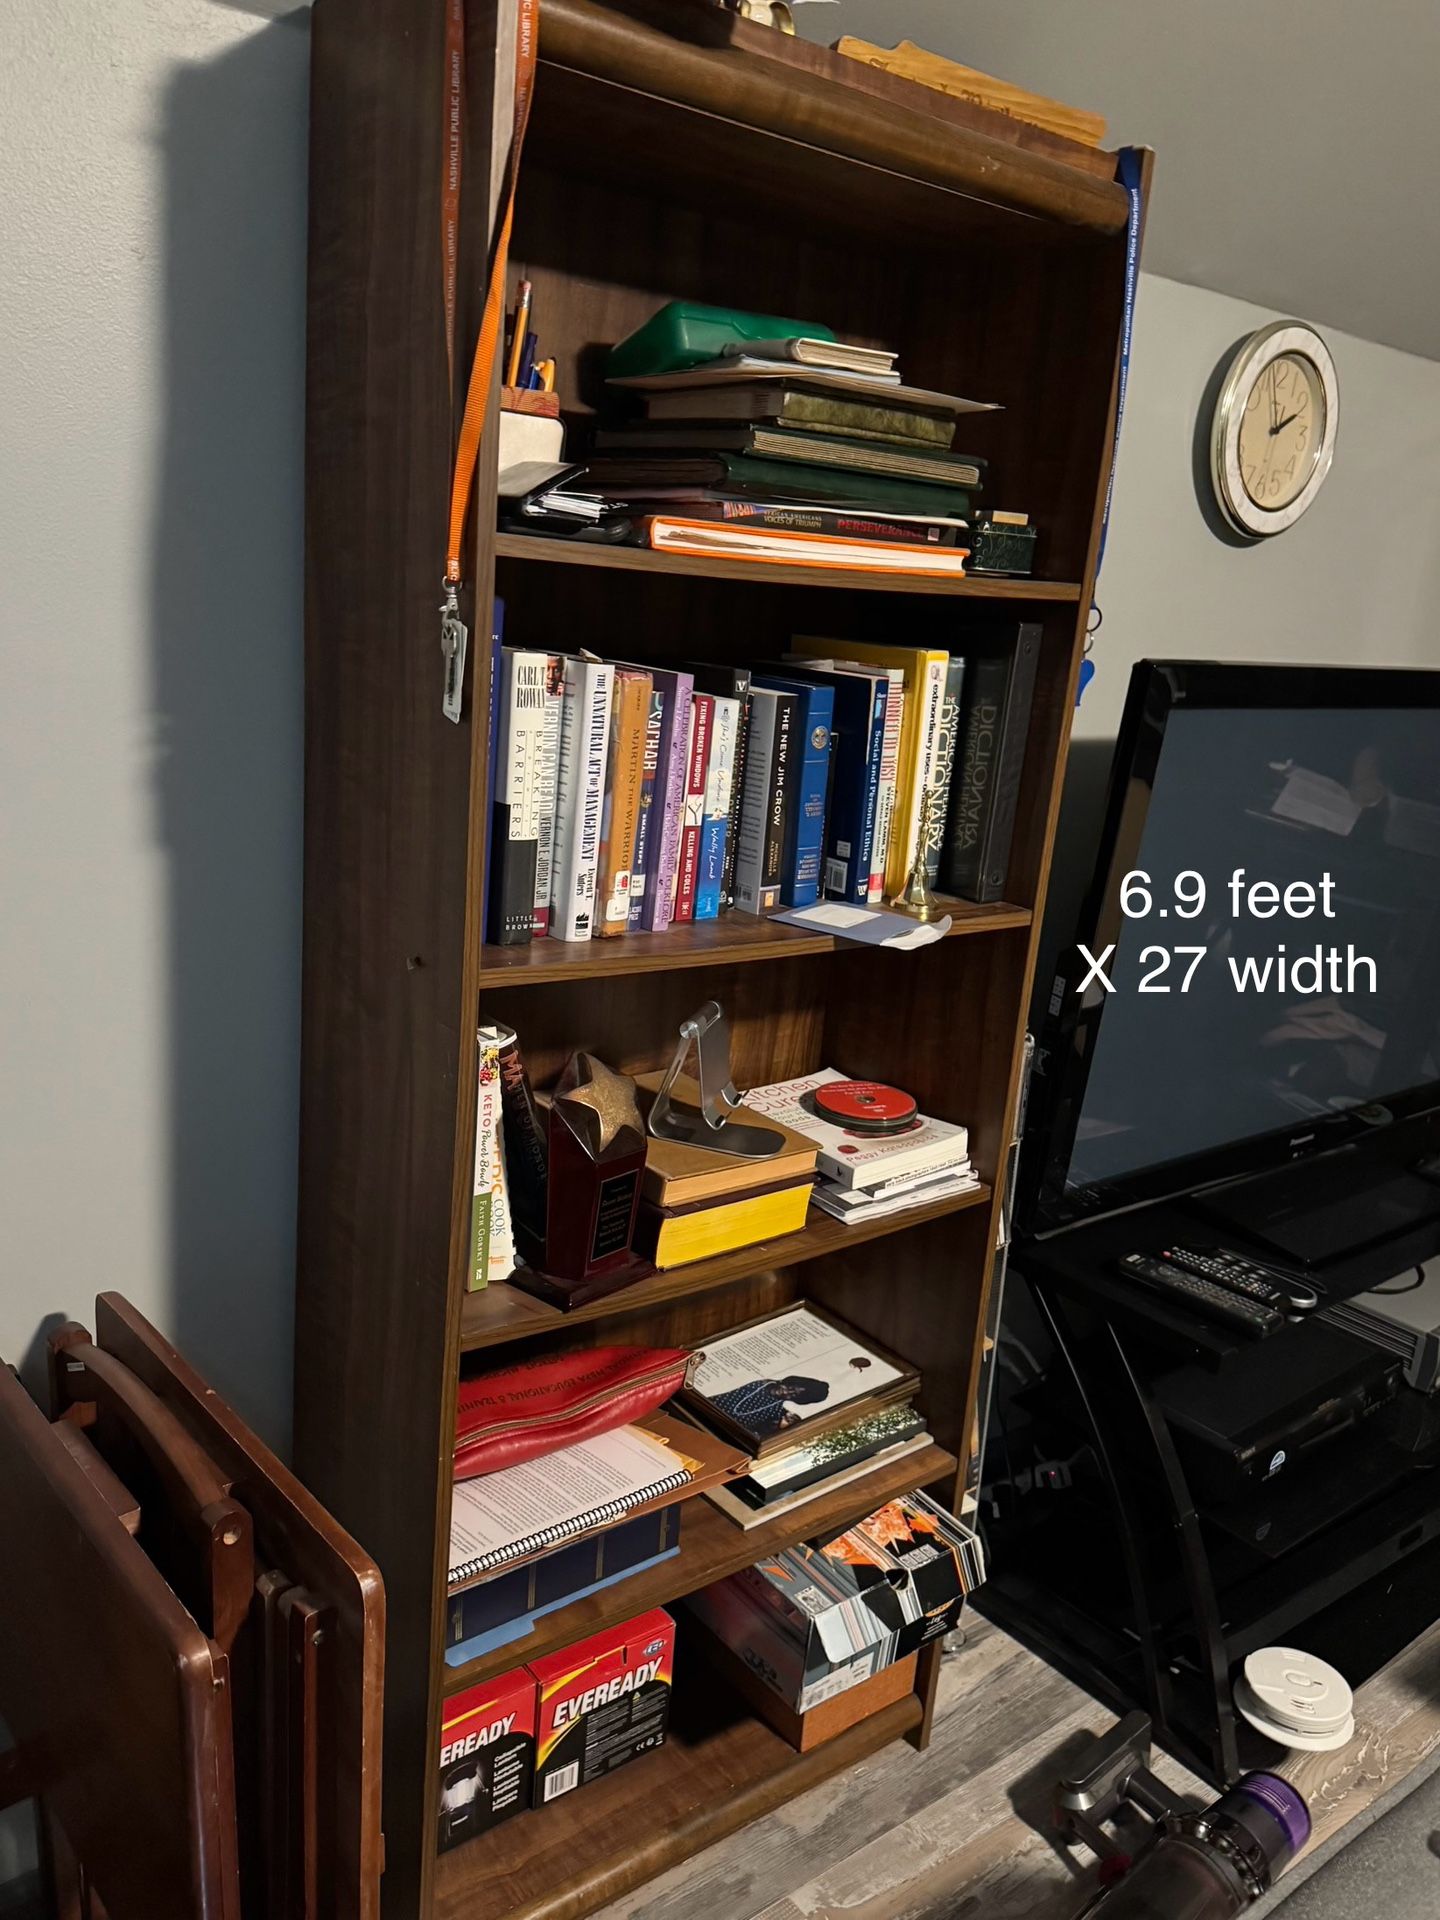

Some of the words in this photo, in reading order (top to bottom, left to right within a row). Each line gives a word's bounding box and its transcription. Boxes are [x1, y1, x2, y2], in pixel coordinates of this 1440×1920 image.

[521, 12, 532, 58] LIBRARY
[451, 51, 462, 93] LIBRARY
[450, 96, 461, 133] PUBLIC
[449, 135, 460, 191] NASHVILLE
[1130, 188, 1139, 236] Department
[447, 219, 458, 262] LIBRARY
[1128, 240, 1138, 264] Police
[1126, 265, 1135, 303] Nashville
[1122, 304, 1132, 356] Metropolitan
[763, 515, 785, 526] VOICES
[795, 518, 822, 529] TRIUMPH
[517, 665, 538, 686] CARL
[596, 672, 607, 689] THE
[589, 690, 607, 753] UNNATURAL
[698, 701, 708, 724] FIXING
[781, 707, 791, 730] THE
[925, 684, 939, 752] extraordinary
[678, 697, 692, 766] CELEBRATION
[696, 725, 706, 753] BROKEN
[779, 734, 789, 763] NEW
[873, 730, 882, 762] Social
[945, 704, 961, 784] AMERICAN
[588, 757, 602, 778] ACT
[629, 729, 641, 784] MARTIN
[692, 754, 704, 788] WINDOWS
[510, 730, 526, 838] BARRIERS
[530, 730, 543, 837] BREAKING
[776, 767, 786, 786] JIM
[927, 704, 953, 851] DICTIONARY
[670, 782, 683, 835] AMERICAN
[773, 790, 784, 826] CROW
[866, 789, 876, 830] Personal
[883, 786, 892, 819] STEVEN
[537, 815, 552, 849] VERNON
[581, 788, 600, 862] MANAGEMENT
[707, 826, 720, 853] Wally
[637, 841, 645, 865] STEPS
[665, 838, 678, 873] FAMILY
[686, 831, 696, 858] KELLING
[862, 830, 873, 862] Ethics
[682, 873, 692, 895] COLES
[708, 855, 718, 879] Lamb
[660, 873, 673, 922] FOLKLORE
[482, 1094, 493, 1128] KETO
[747, 1095, 800, 1113] Cure
[480, 1129, 492, 1158] Power
[478, 1160, 490, 1188] Bowls
[478, 1199, 487, 1227] FAITH
[494, 1198, 506, 1237] COOK
[476, 1228, 486, 1263] GORSKY
[552, 1656, 665, 1729] EVEREADY
[439, 1711, 517, 1769] EREADY
